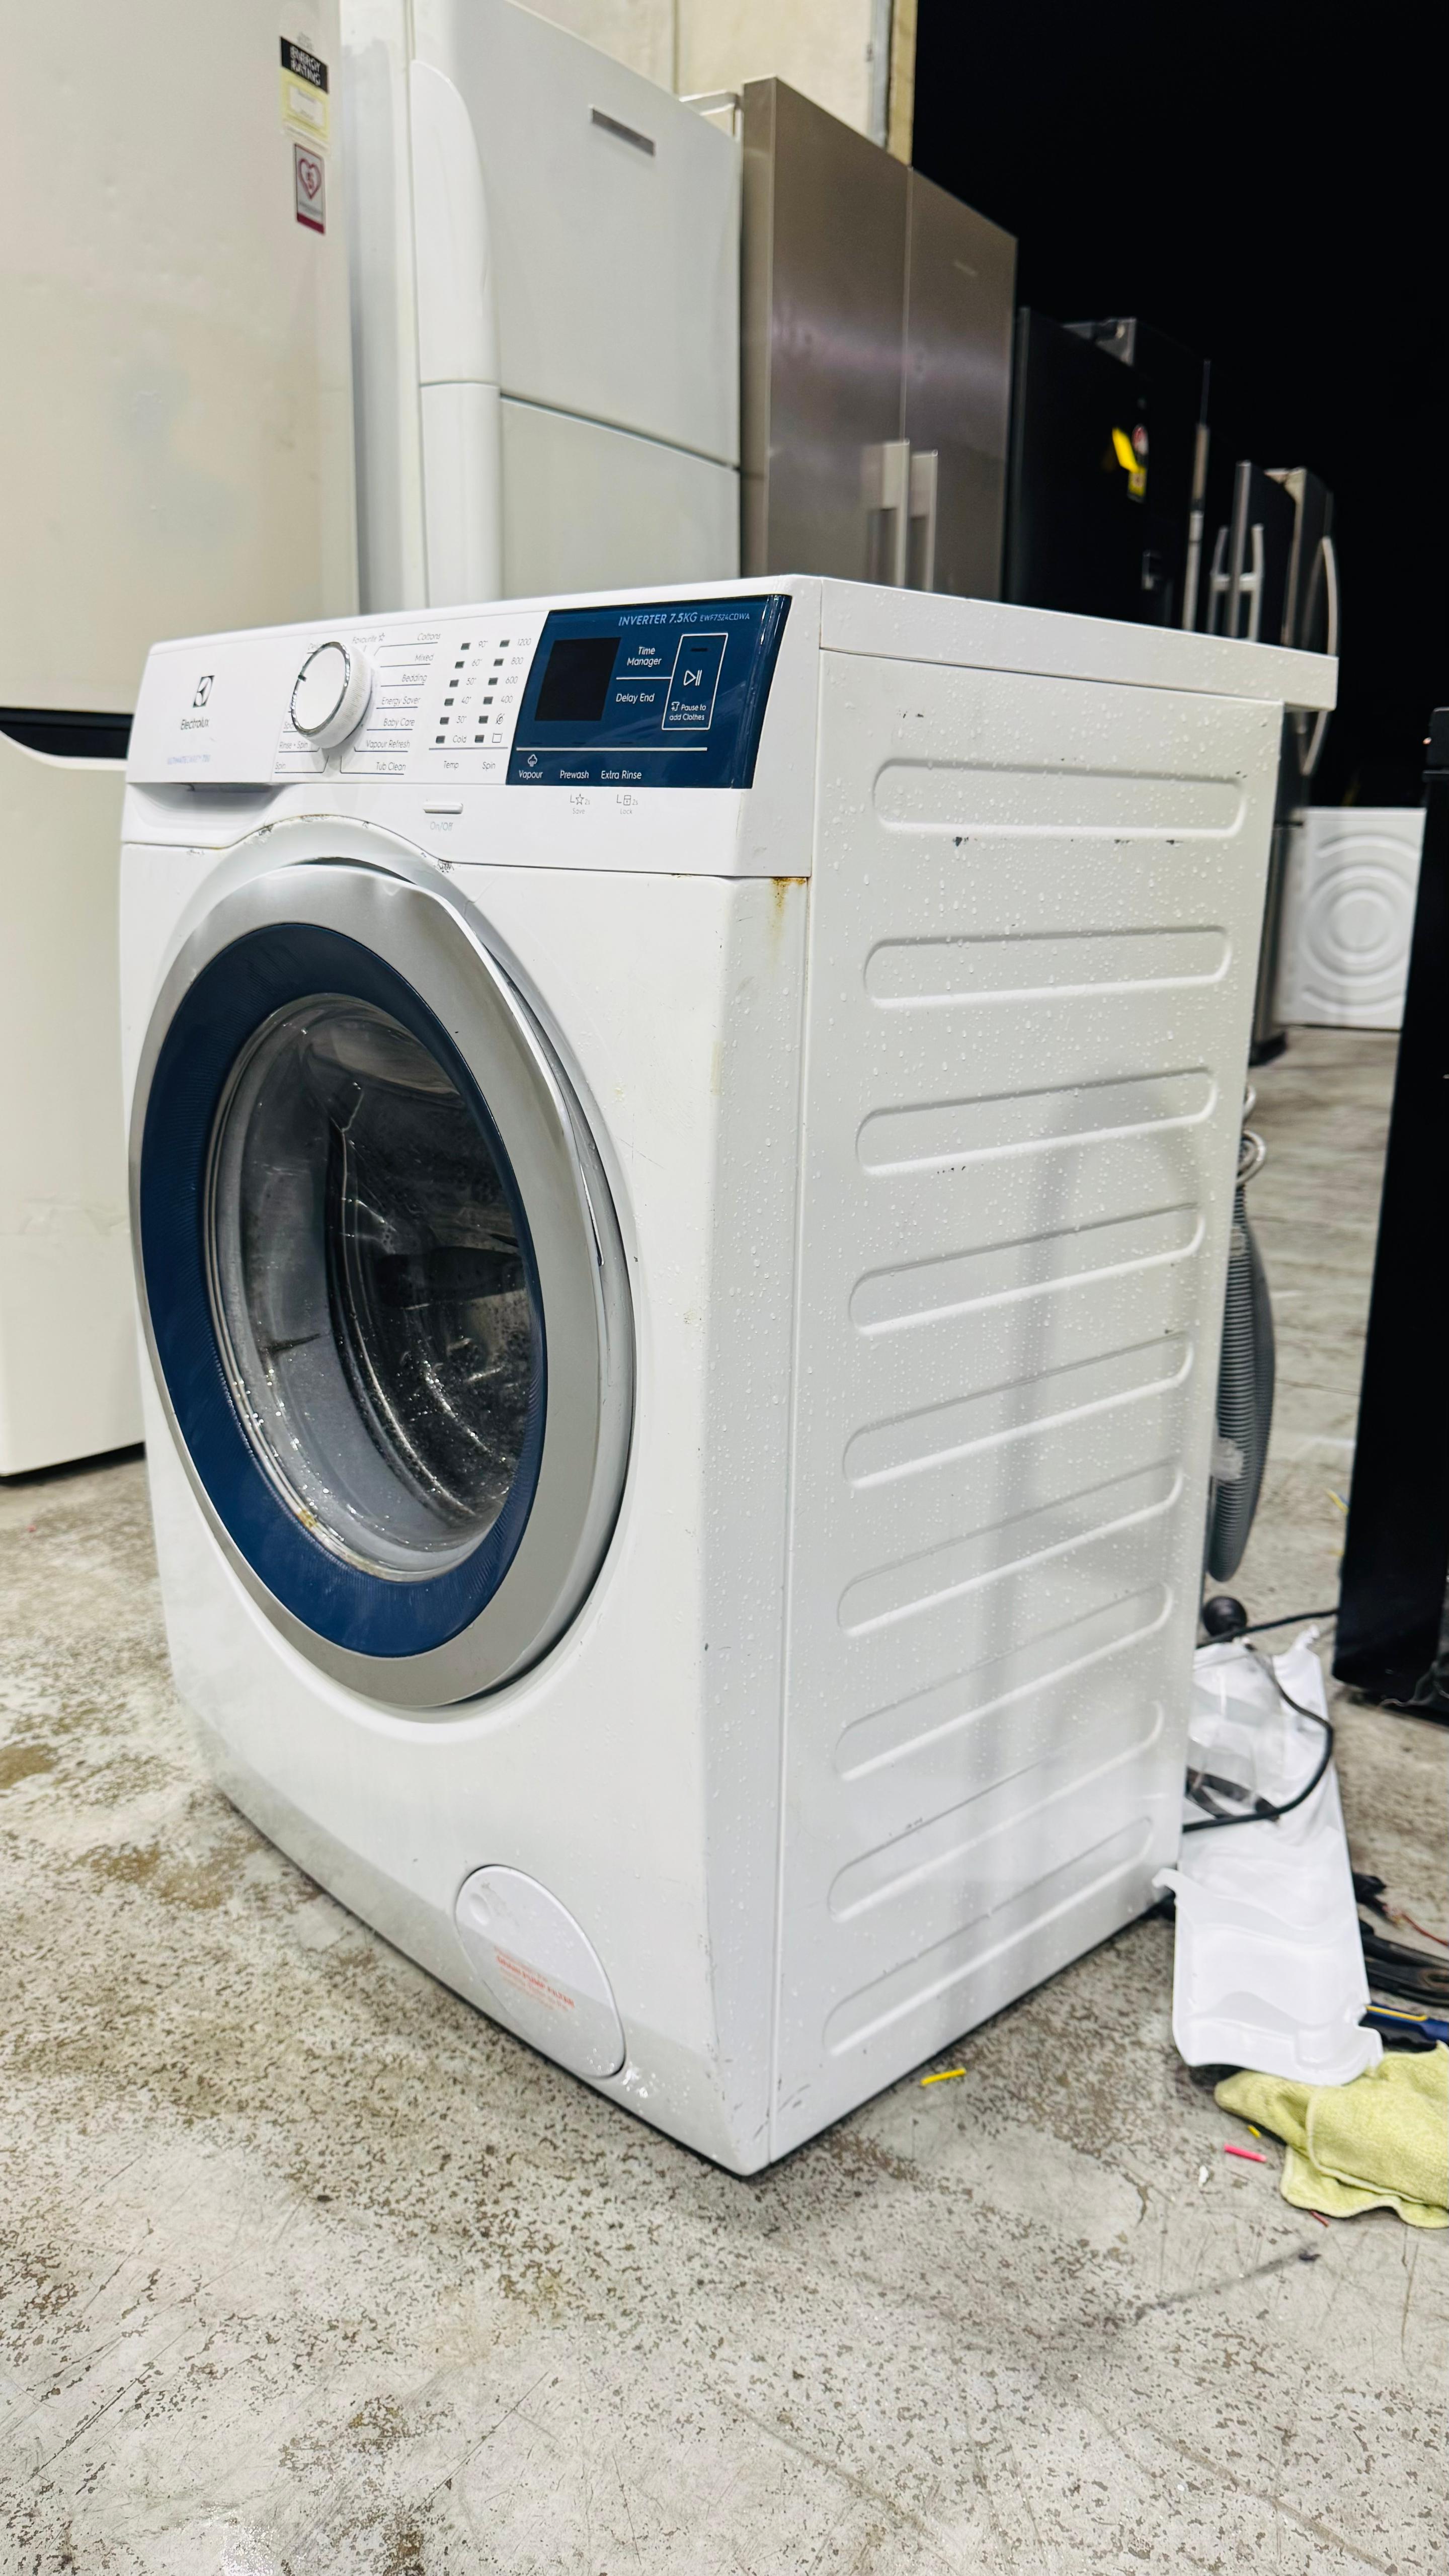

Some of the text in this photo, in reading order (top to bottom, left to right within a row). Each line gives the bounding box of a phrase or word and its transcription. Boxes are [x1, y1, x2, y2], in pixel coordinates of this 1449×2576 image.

[618, 614, 668, 626] INVERTER
[669, 612, 698, 624] 7.5KG
[352, 636, 376, 644] Favourite
[417, 632, 441, 641] Cottons
[517, 638, 531, 646] 1200
[638, 646, 656, 655] Time
[511, 657, 524, 665] 800
[627, 657, 662, 668] Manager
[401, 674, 427, 683] Bedding
[381, 696, 421, 706] Energy Saver
[501, 695, 513, 703] 400
[616, 693, 655, 704] Delay End
[180, 717, 210, 730] Electrolux
[383, 718, 415, 728] Baby Care
[453, 735, 467, 743] Cold
[297, 741, 308, 749] Spin
[366, 740, 410, 749] Vapour Refresh
[275, 762, 286, 770] Spin
[376, 762, 406, 771] Tub Clean
[443, 761, 459, 770] Temp
[482, 761, 496, 771] Spin
[519, 770, 543, 779] Vapour
[559, 770, 589, 778] Prewash
[601, 770, 642, 779] Extra Rinse
[430, 822, 453, 831] On/Off
